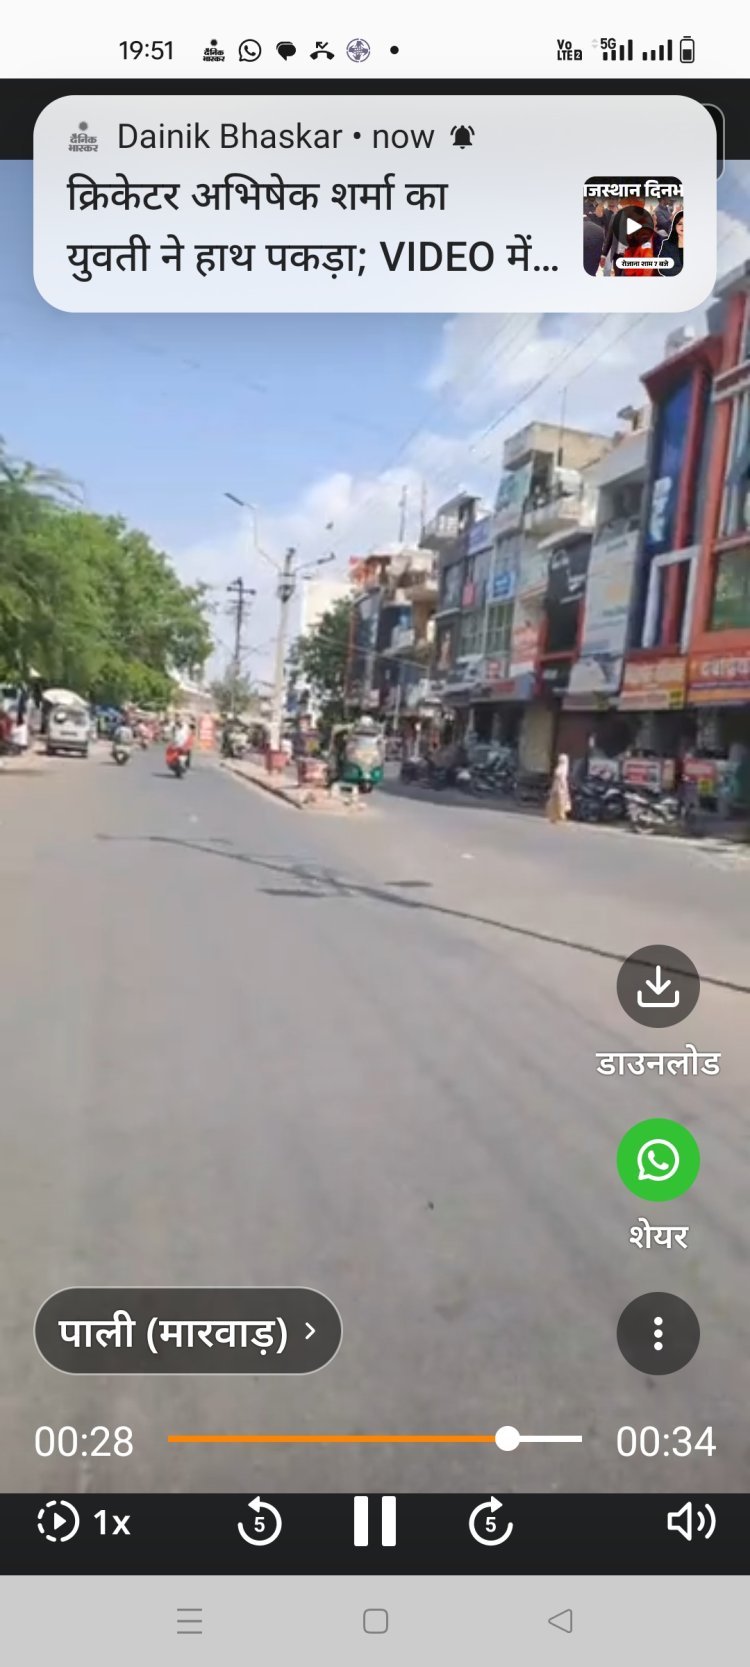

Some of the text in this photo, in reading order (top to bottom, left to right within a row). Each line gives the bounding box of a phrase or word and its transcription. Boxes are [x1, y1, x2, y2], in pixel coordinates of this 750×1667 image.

[119, 40, 173, 61] 19:51
[556, 39, 573, 50] Vo
[600, 37, 617, 49] 5G
[118, 121, 435, 149] Dainik Bhaskar now
[66, 172, 449, 211] क्रिकेटर अभिषेक शर्मा का
[66, 233, 151, 283] युवती
[159, 233, 185, 272] ने
[193, 244, 257, 278] हाथ
[264, 244, 366, 280] पकड़ा;
[379, 240, 494, 272] VIDEO
[595, 1043, 722, 1076] डाउनलोड
[629, 1217, 690, 1249] शेयर
[58, 1309, 289, 1356] पाली (मारवाड़)
[34, 1425, 134, 1457] 00:28
[616, 1426, 717, 1457] 00:34
[93, 1509, 131, 1535] 1x
[254, 1516, 266, 1533] 5
[485, 1516, 497, 1533] 5
